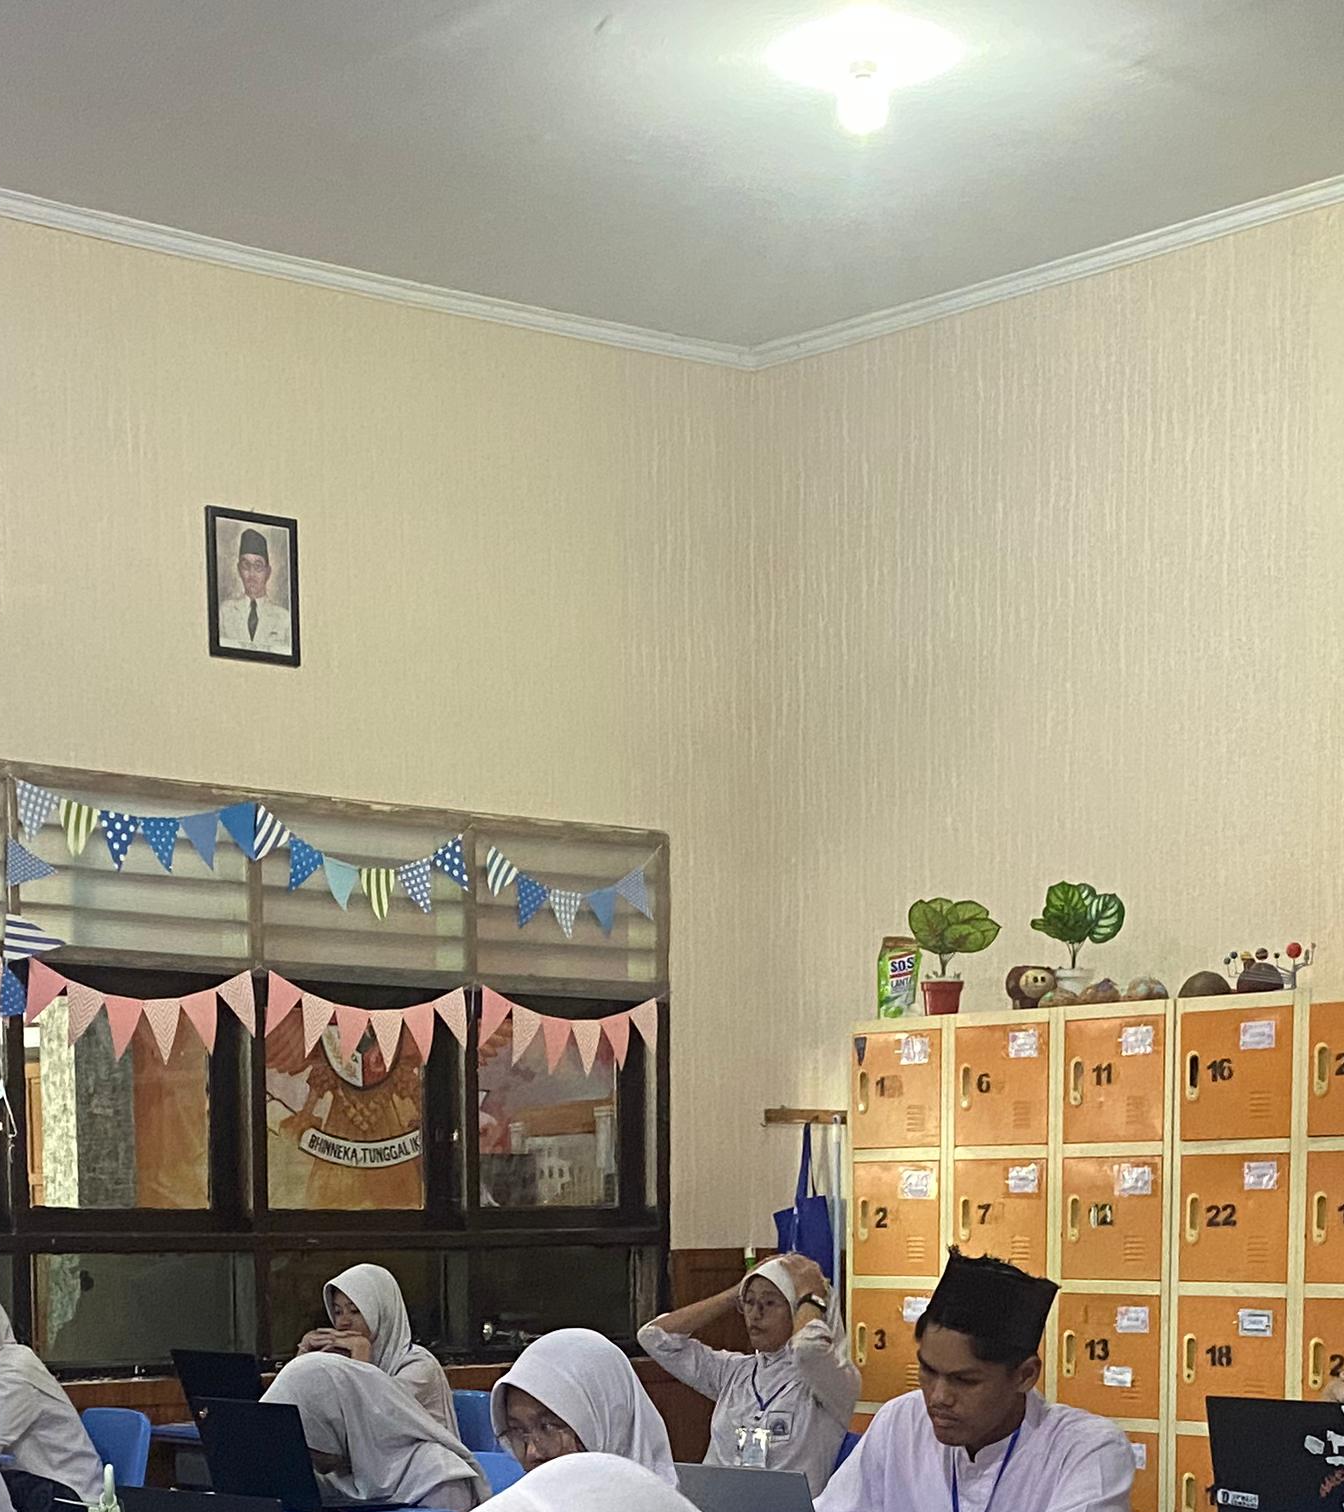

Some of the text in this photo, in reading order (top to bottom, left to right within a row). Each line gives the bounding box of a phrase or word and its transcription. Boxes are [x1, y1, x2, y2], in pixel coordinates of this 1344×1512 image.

[1092, 1063, 1113, 1086] 11
[1207, 1058, 1234, 1082] 16
[976, 1073, 991, 1094] 6
[308, 1133, 421, 1164] BHINNEKA TUNGGAL IK
[875, 1207, 888, 1229] 2
[977, 1204, 992, 1225] 7
[1206, 1204, 1237, 1228] 22
[874, 1329, 887, 1350] 3
[1085, 1338, 1110, 1361] 13
[1205, 1345, 1232, 1367] 18
